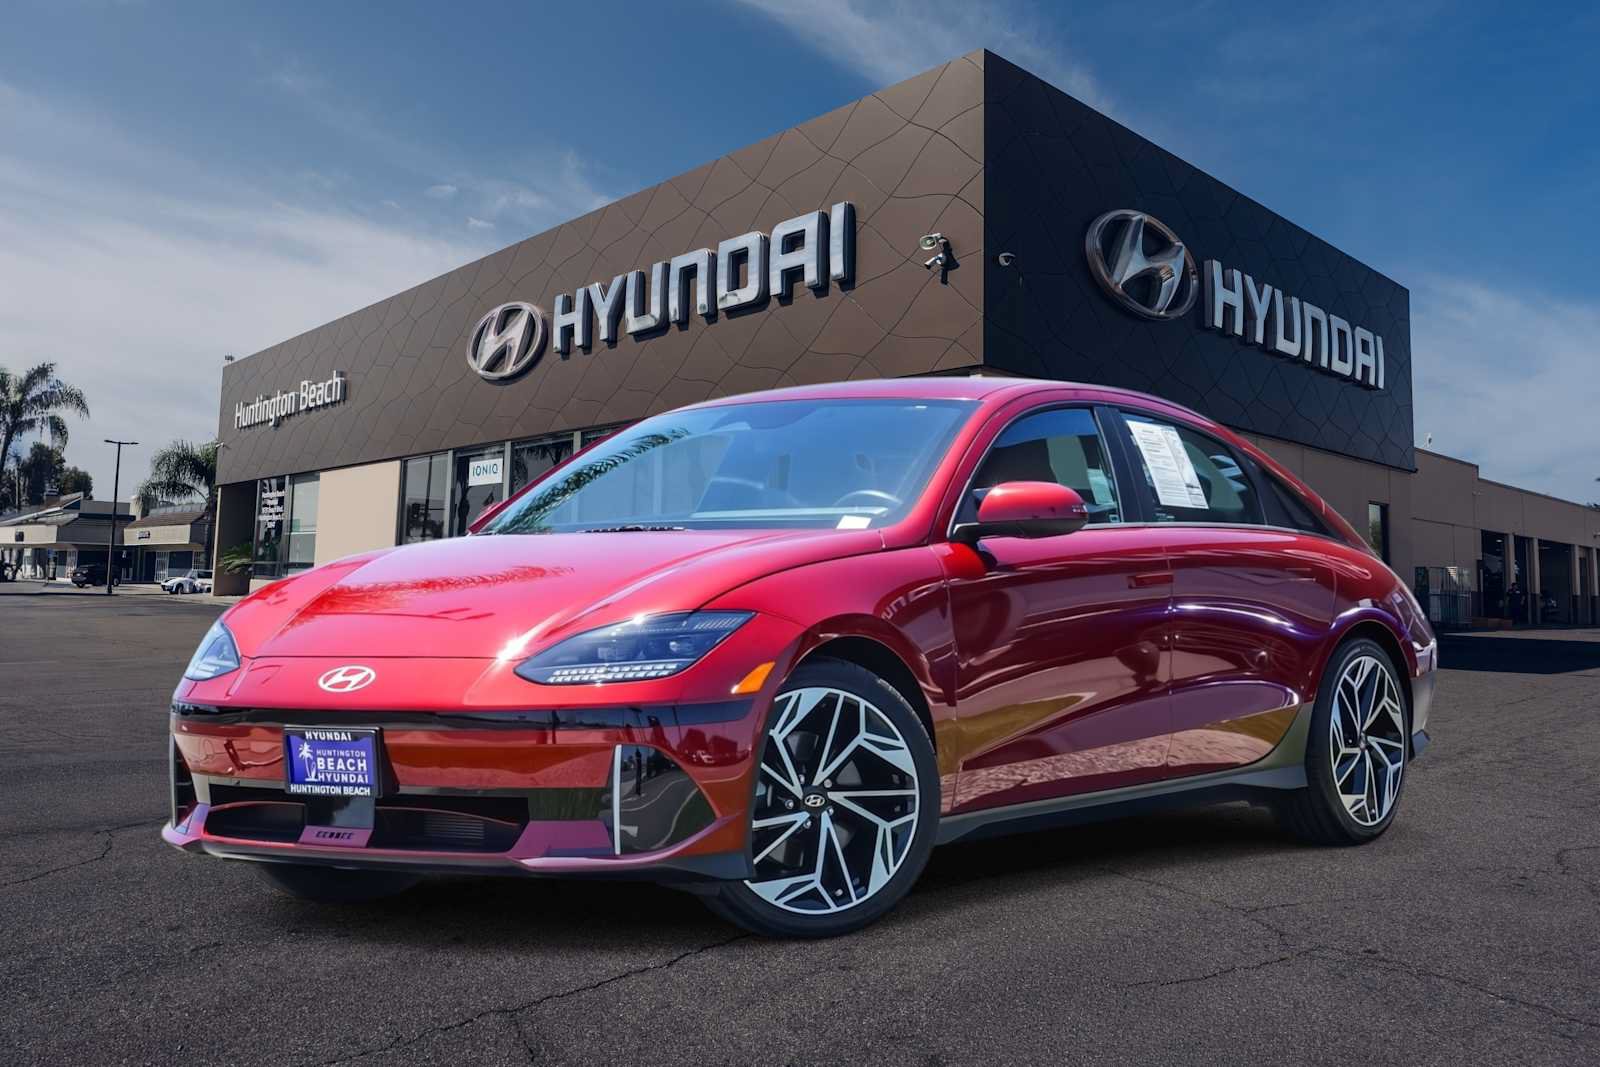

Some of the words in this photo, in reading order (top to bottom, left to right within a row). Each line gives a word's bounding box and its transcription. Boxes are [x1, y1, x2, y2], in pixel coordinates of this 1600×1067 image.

[553, 200, 854, 354] HYUNDAI
[1205, 258, 1385, 390] HYUNDAI
[234, 389, 299, 430] Huntington
[299, 370, 344, 412] Beach
[472, 463, 499, 477] IONIQ
[305, 731, 352, 741] HYUNDAI
[316, 749, 366, 758] HUNTINGTON
[317, 757, 367, 771] BEACH
[318, 772, 369, 784] HYUNDAI
[290, 783, 342, 795] HUNTINGTON
[343, 786, 371, 797] BEACH
